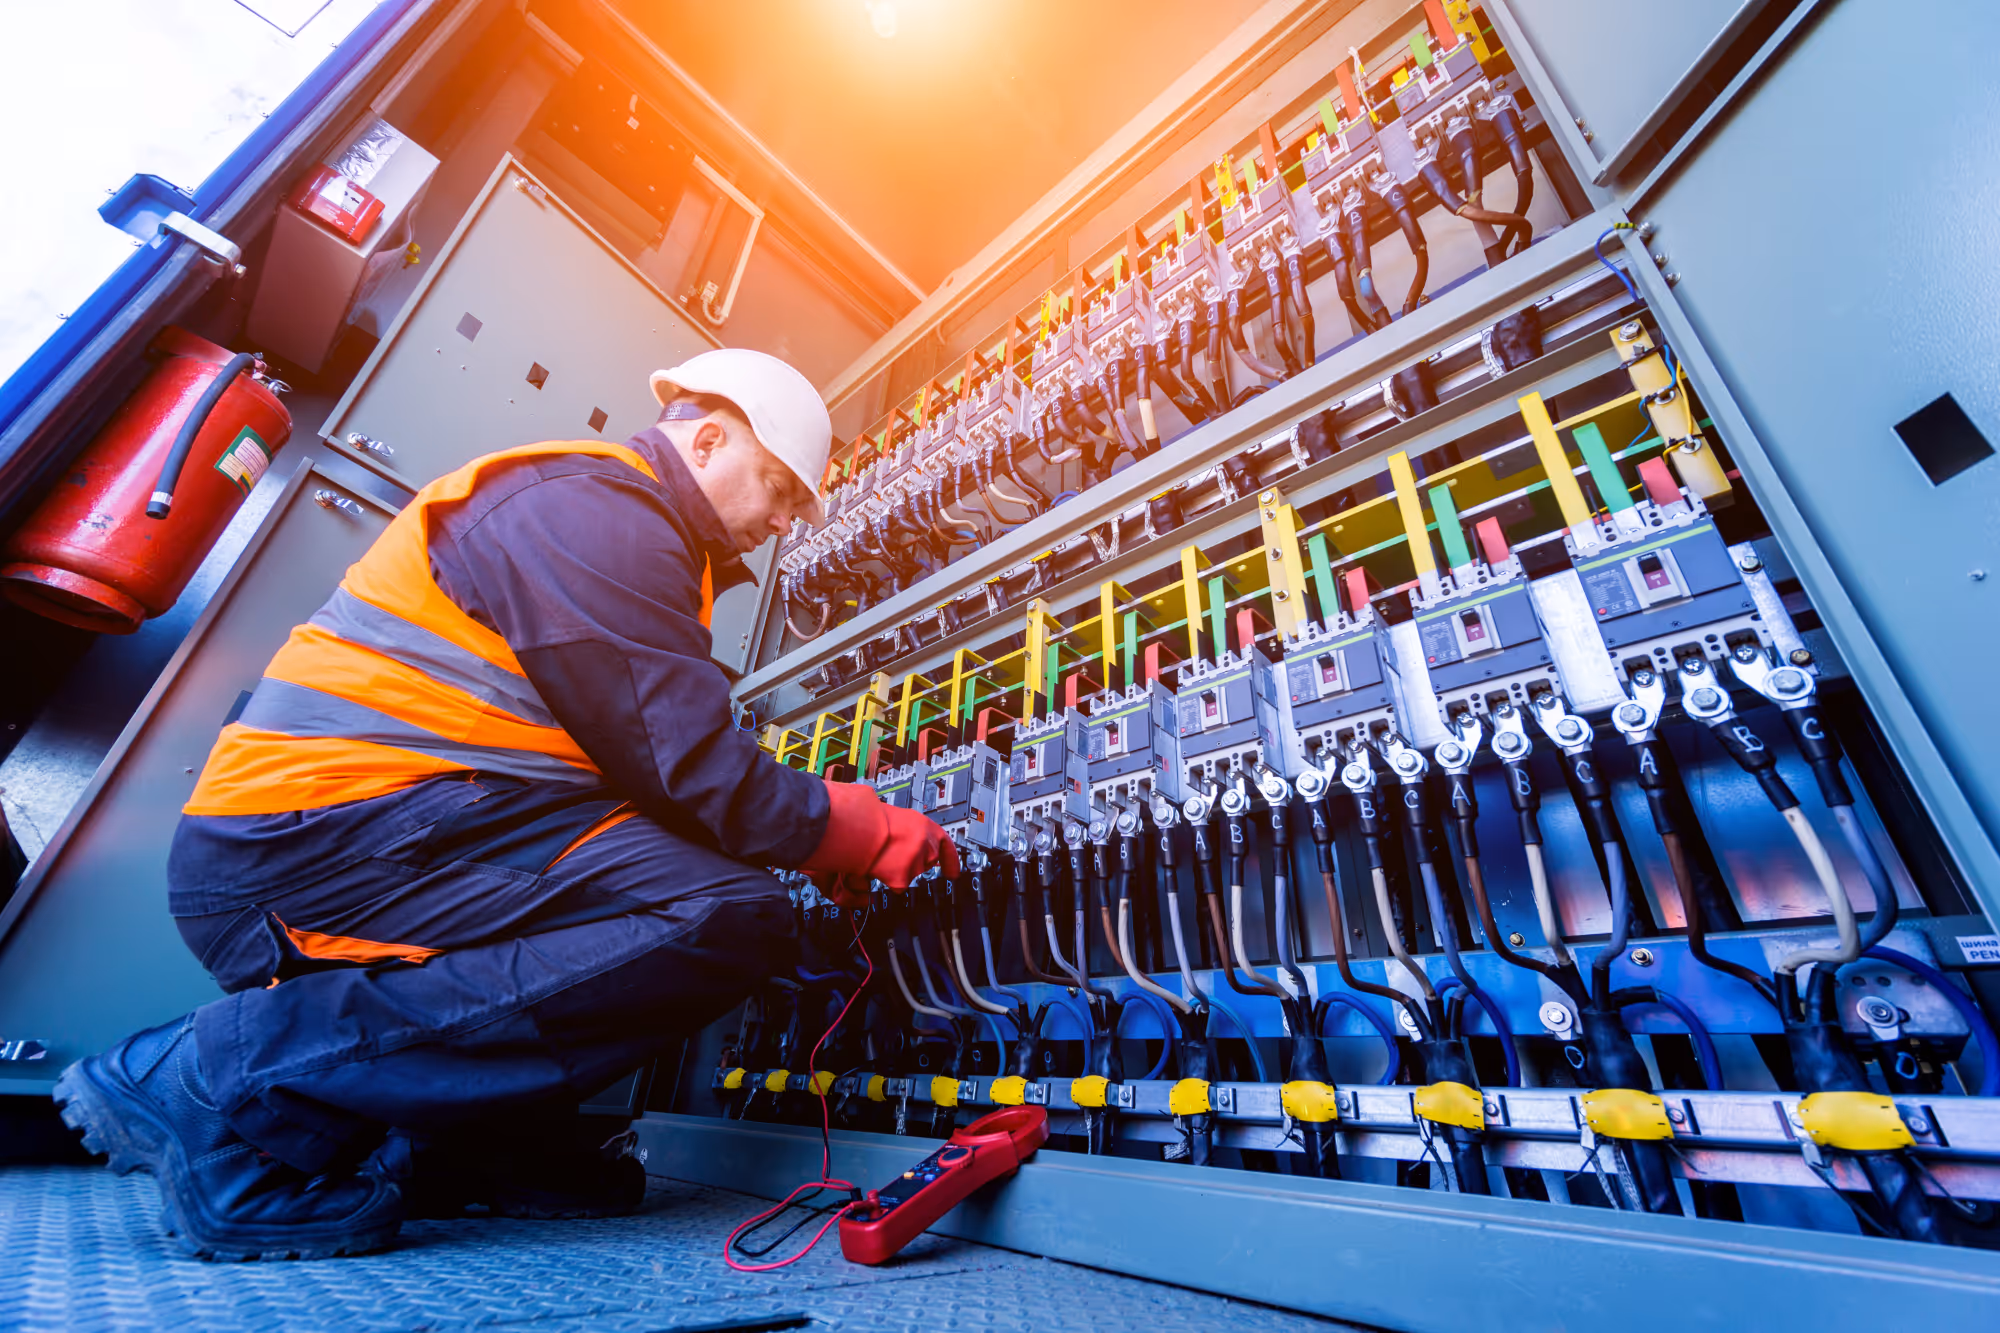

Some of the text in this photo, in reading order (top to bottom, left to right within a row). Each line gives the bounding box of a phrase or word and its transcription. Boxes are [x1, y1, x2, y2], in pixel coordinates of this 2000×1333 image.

[1392, 191, 1401, 201] C
[1350, 211, 1362, 226] B
[1330, 238, 1341, 254] A
[1267, 273, 1278, 288] B
[1228, 294, 1239, 309] A
[1206, 307, 1214, 321] C
[1179, 324, 1189, 340] B
[1134, 349, 1141, 361] C
[1155, 343, 1166, 358] A
[1110, 363, 1118, 376] B
[1098, 377, 1107, 390] A
[1052, 401, 1061, 414] B
[1802, 717, 1825, 740] C
[1732, 726, 1764, 752] B
[1640, 747, 1658, 775] A
[1575, 760, 1594, 784] C
[1514, 768, 1532, 796] B
[1404, 790, 1419, 809] C
[1451, 781, 1472, 808] A
[1360, 799, 1376, 819] B
[1272, 815, 1283, 830] C
[1312, 809, 1325, 829] A
[1195, 831, 1207, 852] A
[1230, 824, 1244, 843] B
[1120, 843, 1128, 859] B
[1161, 836, 1169, 852] C
[1038, 861, 1045, 876] B
[1070, 856, 1078, 869] C
[1093, 853, 1101, 871] A
[946, 879, 953, 895] B
[830, 906, 840, 919] B
[1969, 950, 2000, 960] PEN
